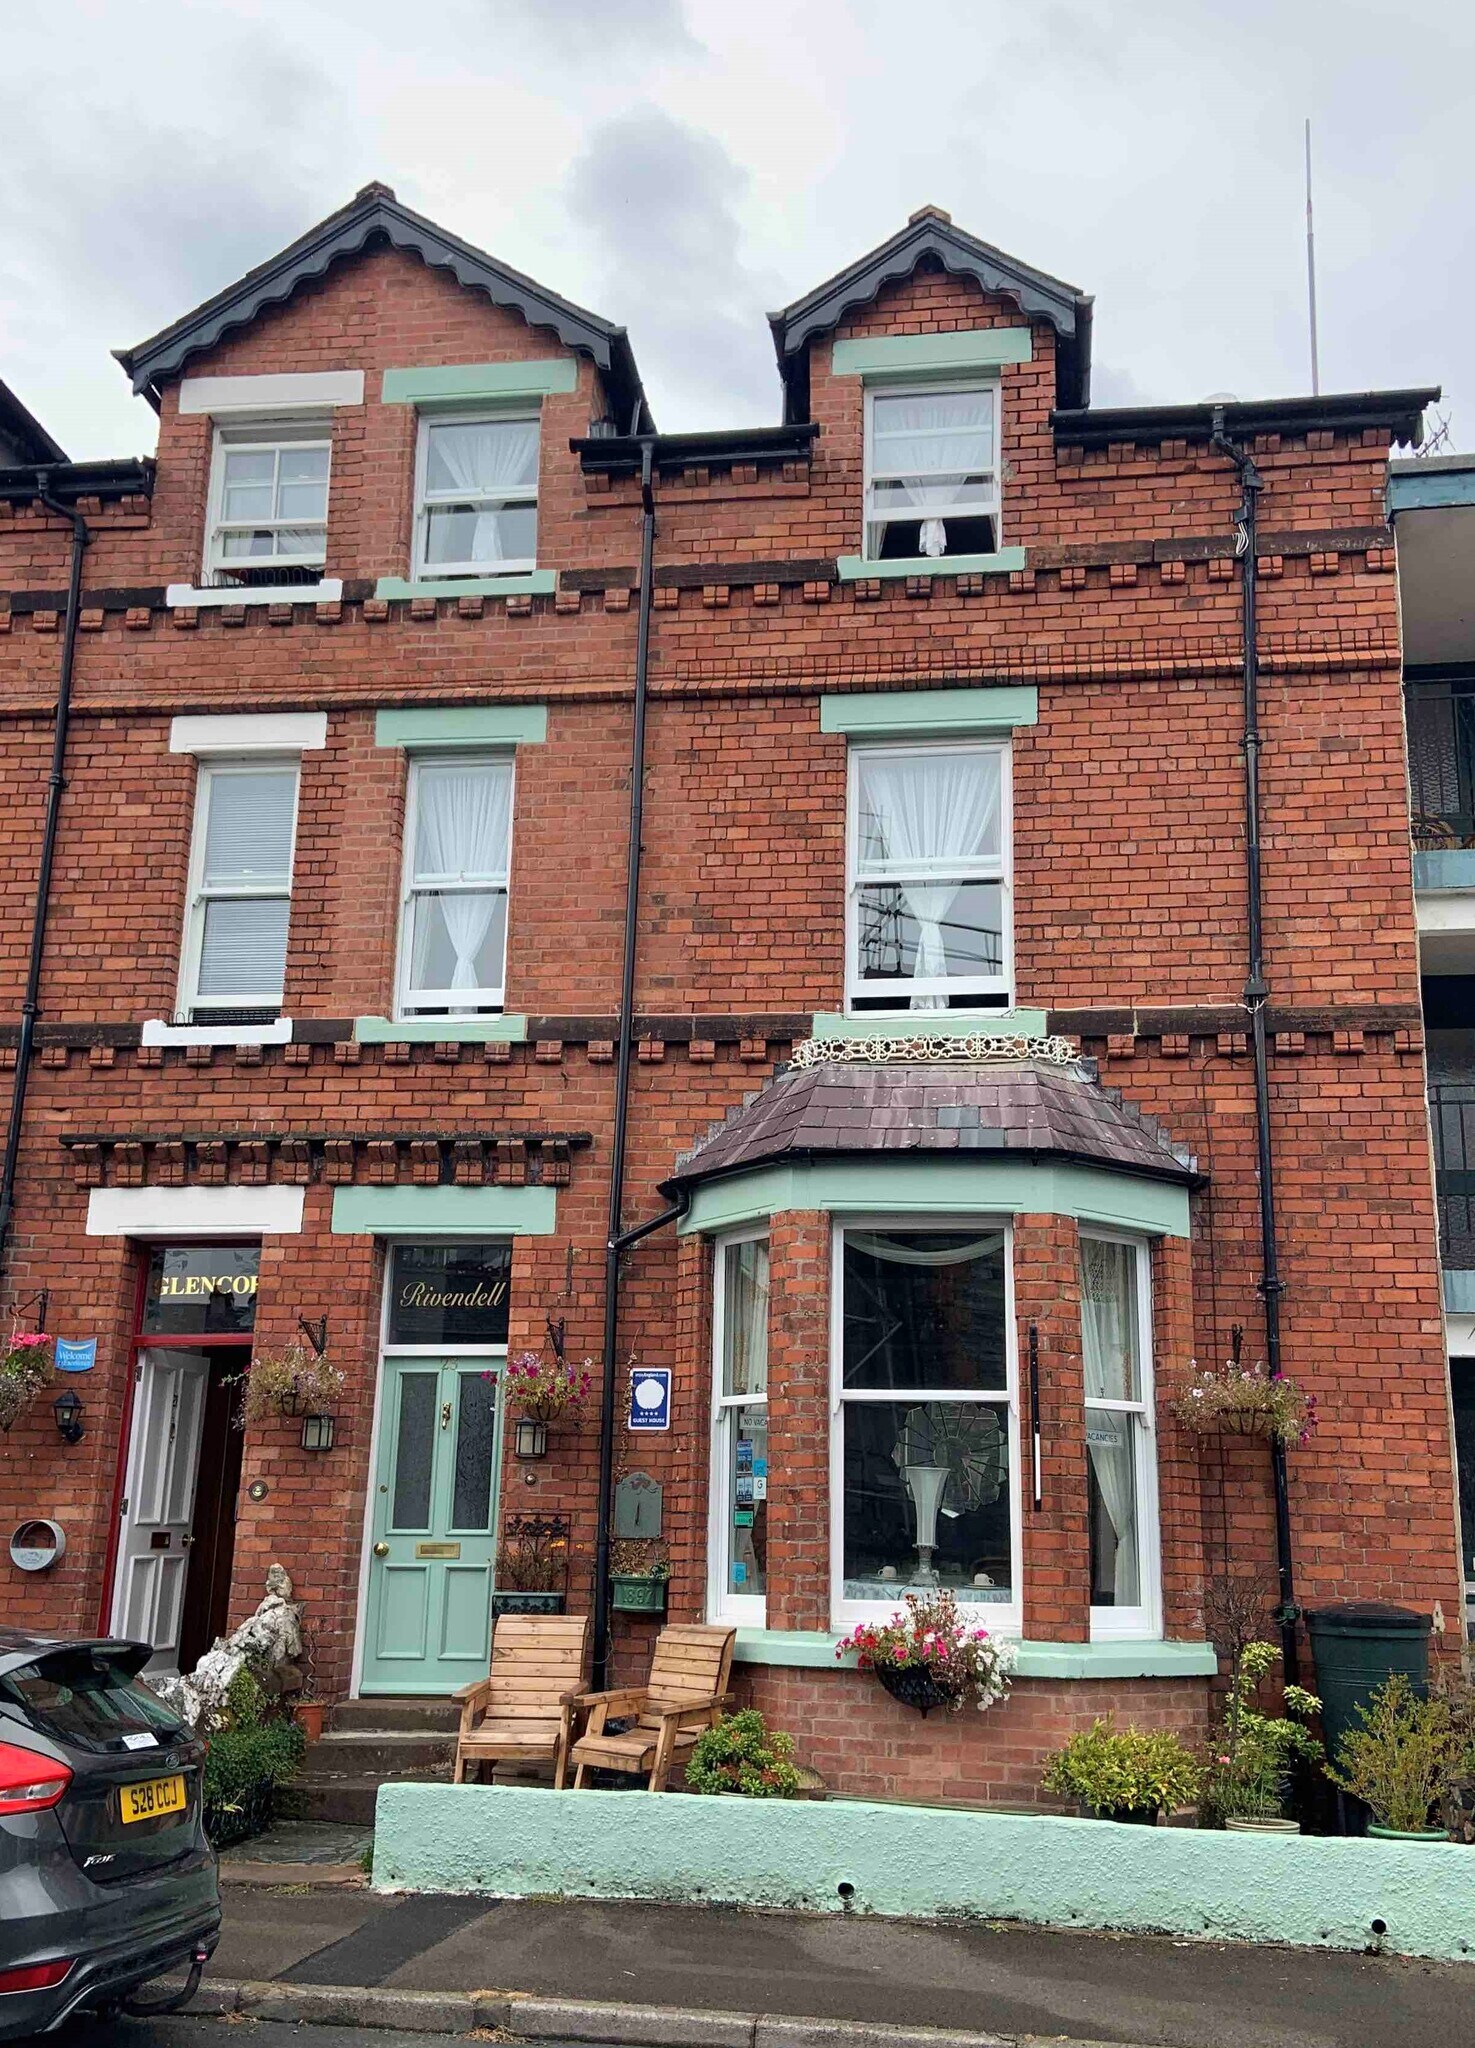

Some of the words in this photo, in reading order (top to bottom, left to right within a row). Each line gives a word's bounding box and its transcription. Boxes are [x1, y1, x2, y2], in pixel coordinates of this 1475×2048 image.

[400, 1281, 507, 1307] Rivendell
[59, 1351, 92, 1361] Welcome
[743, 1418, 753, 1426] NO
[1086, 1431, 1118, 1443] ACANCIES
[130, 1785, 154, 1815] S28
[155, 1779, 178, 1809] CCJ
